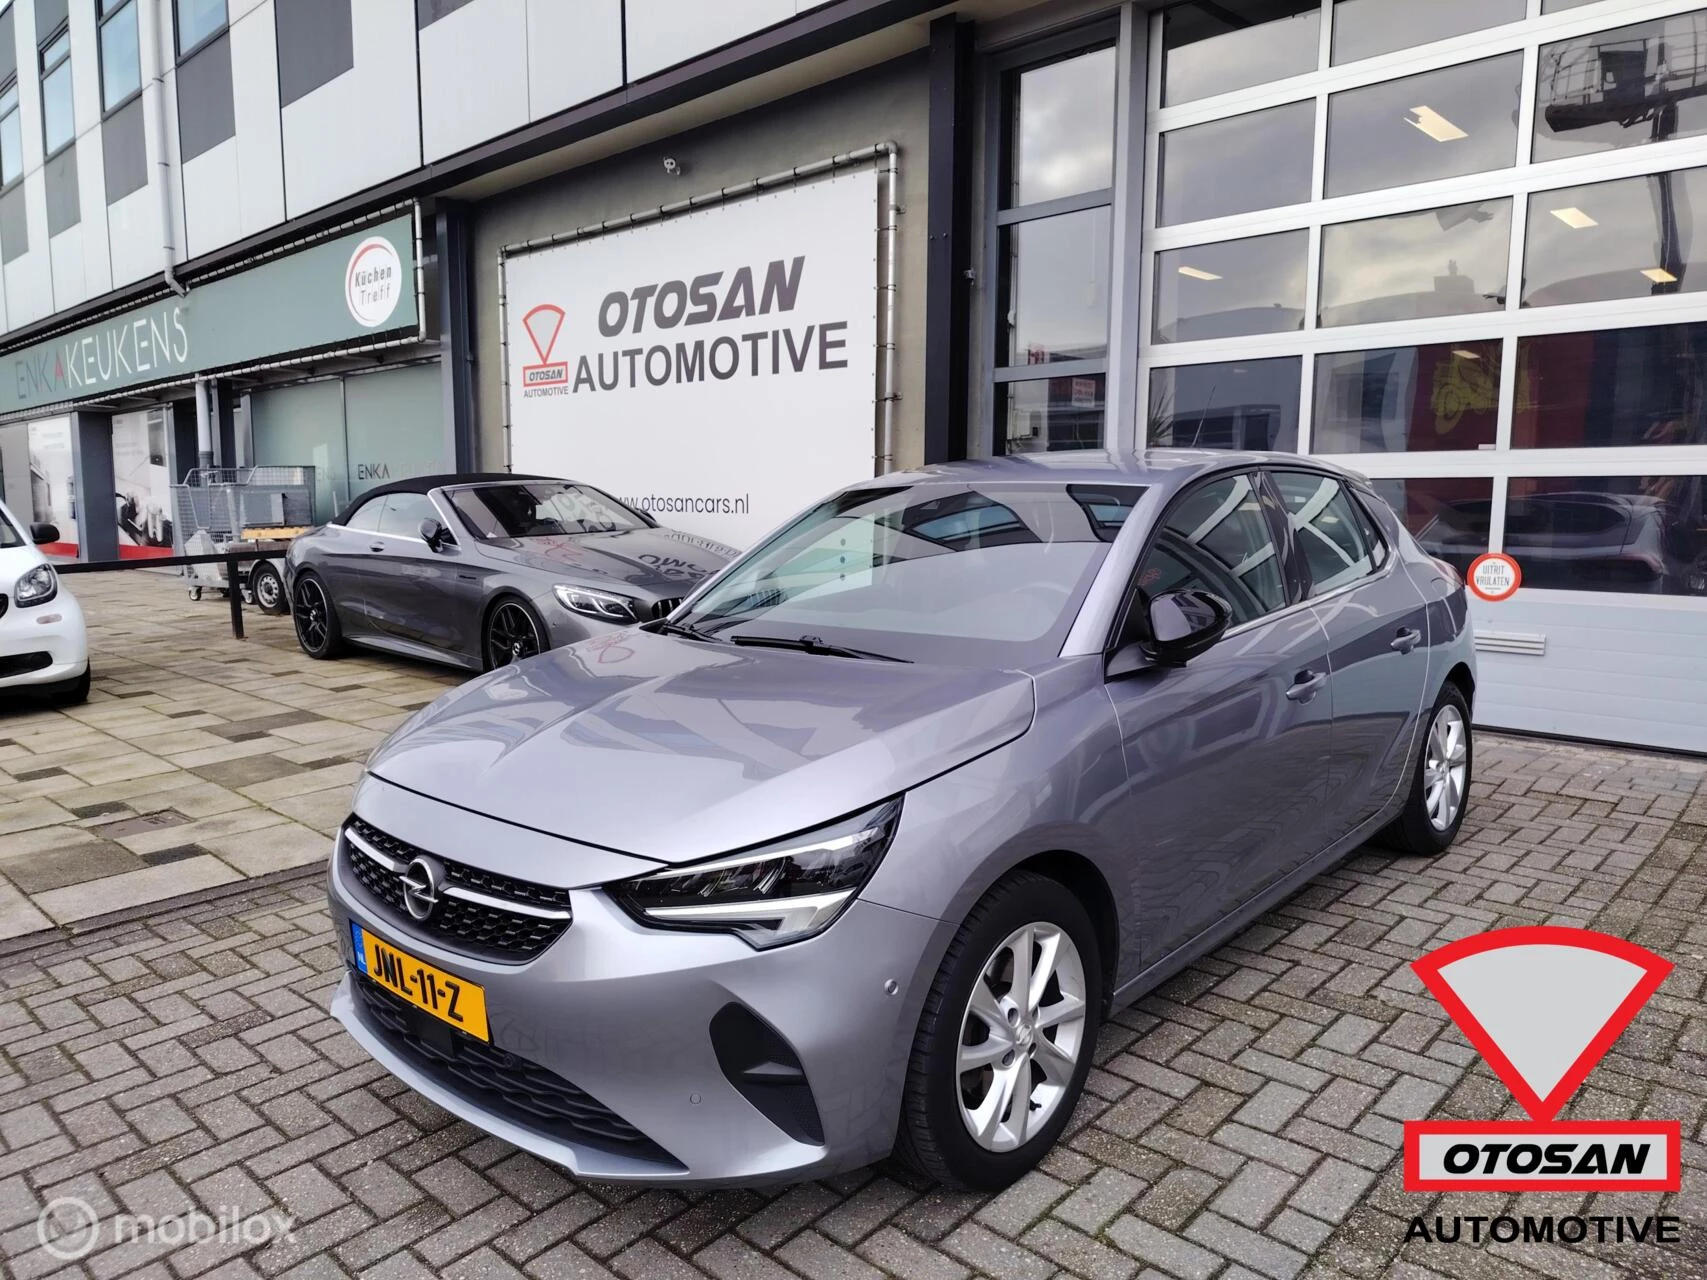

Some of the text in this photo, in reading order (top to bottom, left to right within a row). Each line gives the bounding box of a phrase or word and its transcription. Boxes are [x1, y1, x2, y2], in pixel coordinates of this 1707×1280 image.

[355, 266, 392, 288] Küchen
[361, 283, 391, 305] Treff
[598, 255, 806, 338] OTOSAN
[572, 321, 848, 394] AUTOMOTIVE
[529, 368, 564, 381] OTOSAN
[523, 386, 569, 398] AUTOMOTIVE
[357, 463, 390, 480] ENKA
[1482, 564, 1505, 575] UITRIT
[374, 944, 464, 1022] JNL-11-Z
